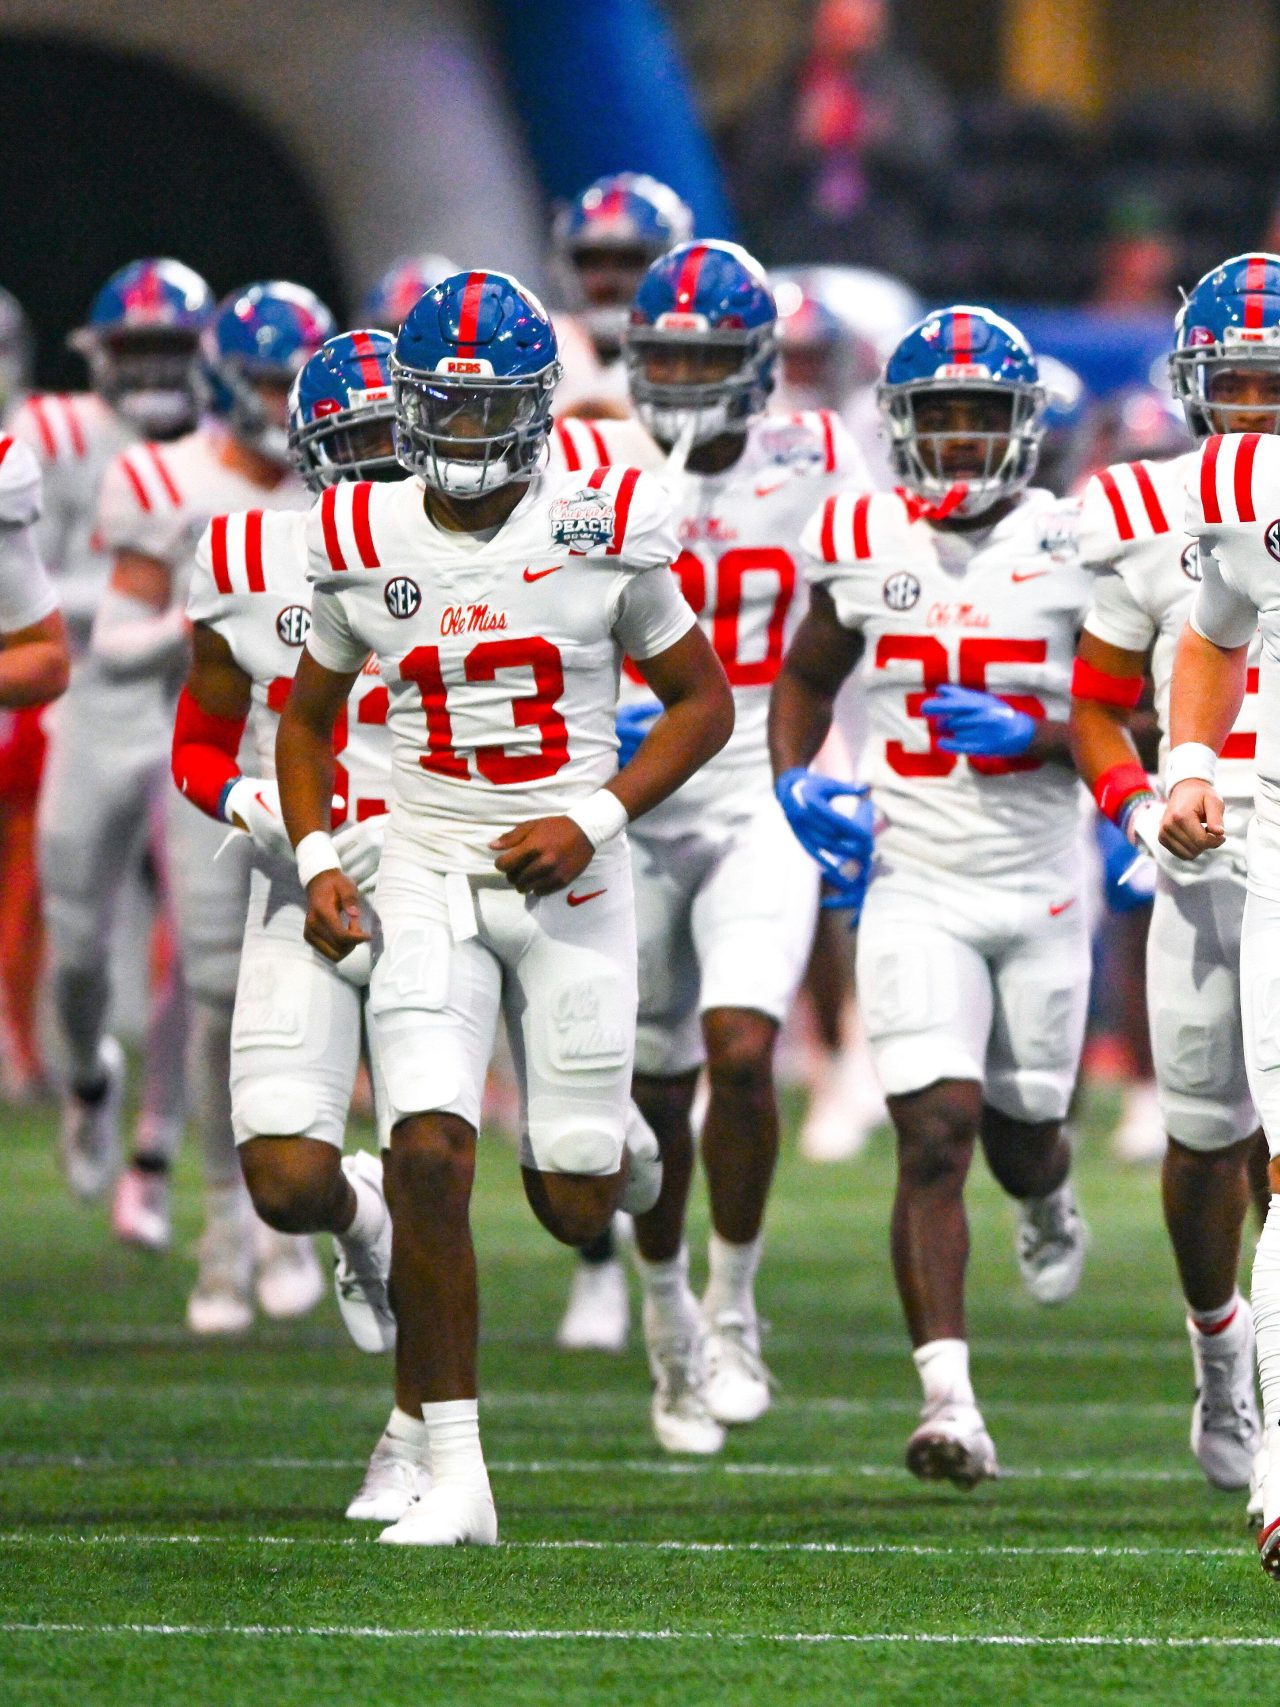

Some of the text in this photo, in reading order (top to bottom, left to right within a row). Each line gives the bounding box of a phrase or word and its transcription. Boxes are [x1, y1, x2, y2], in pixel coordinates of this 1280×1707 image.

[447, 361, 481, 374] REBS
[551, 519, 612, 538] PEACH
[386, 578, 419, 617] SEC
[279, 606, 312, 644] SEC
[440, 604, 508, 636] Ole Miss
[399, 635, 571, 785] 13
[875, 633, 1047, 778] 35
